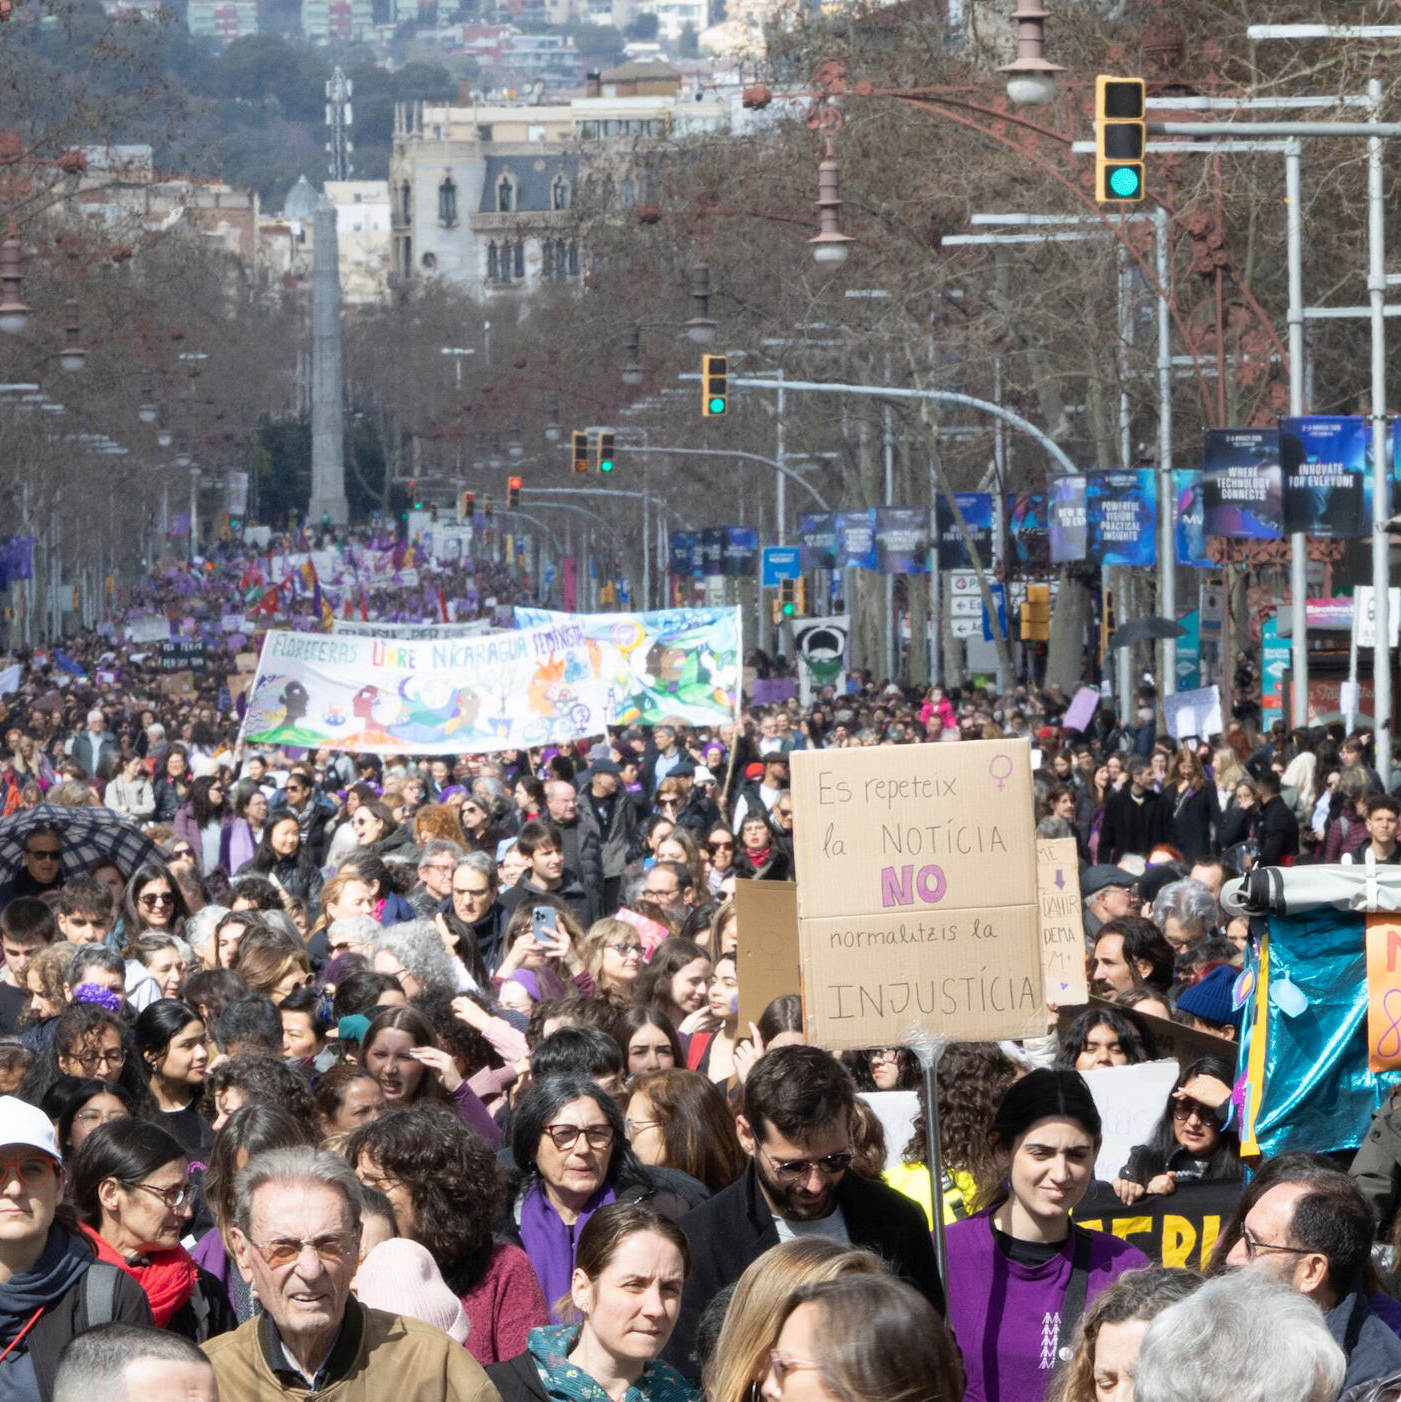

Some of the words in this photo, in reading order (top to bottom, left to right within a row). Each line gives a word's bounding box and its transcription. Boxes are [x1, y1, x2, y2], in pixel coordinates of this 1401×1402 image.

[1228, 466, 1258, 477] WHERE
[1299, 464, 1344, 475] INNOVATE
[1216, 478, 1270, 488] TECHNOLOGY
[1289, 476, 1305, 488] FOR
[1308, 476, 1354, 488] EVERYONE
[1222, 488, 1266, 500] CONNECTS
[819, 771, 852, 805] Es
[864, 772, 957, 810] repeteix
[823, 823, 846, 860] la
[882, 818, 1008, 856] NOTÍCIA
[880, 864, 948, 908] NO
[830, 918, 957, 949] normalitzis
[971, 918, 998, 940] la
[827, 966, 1037, 1020] INJUSTÍCIA
